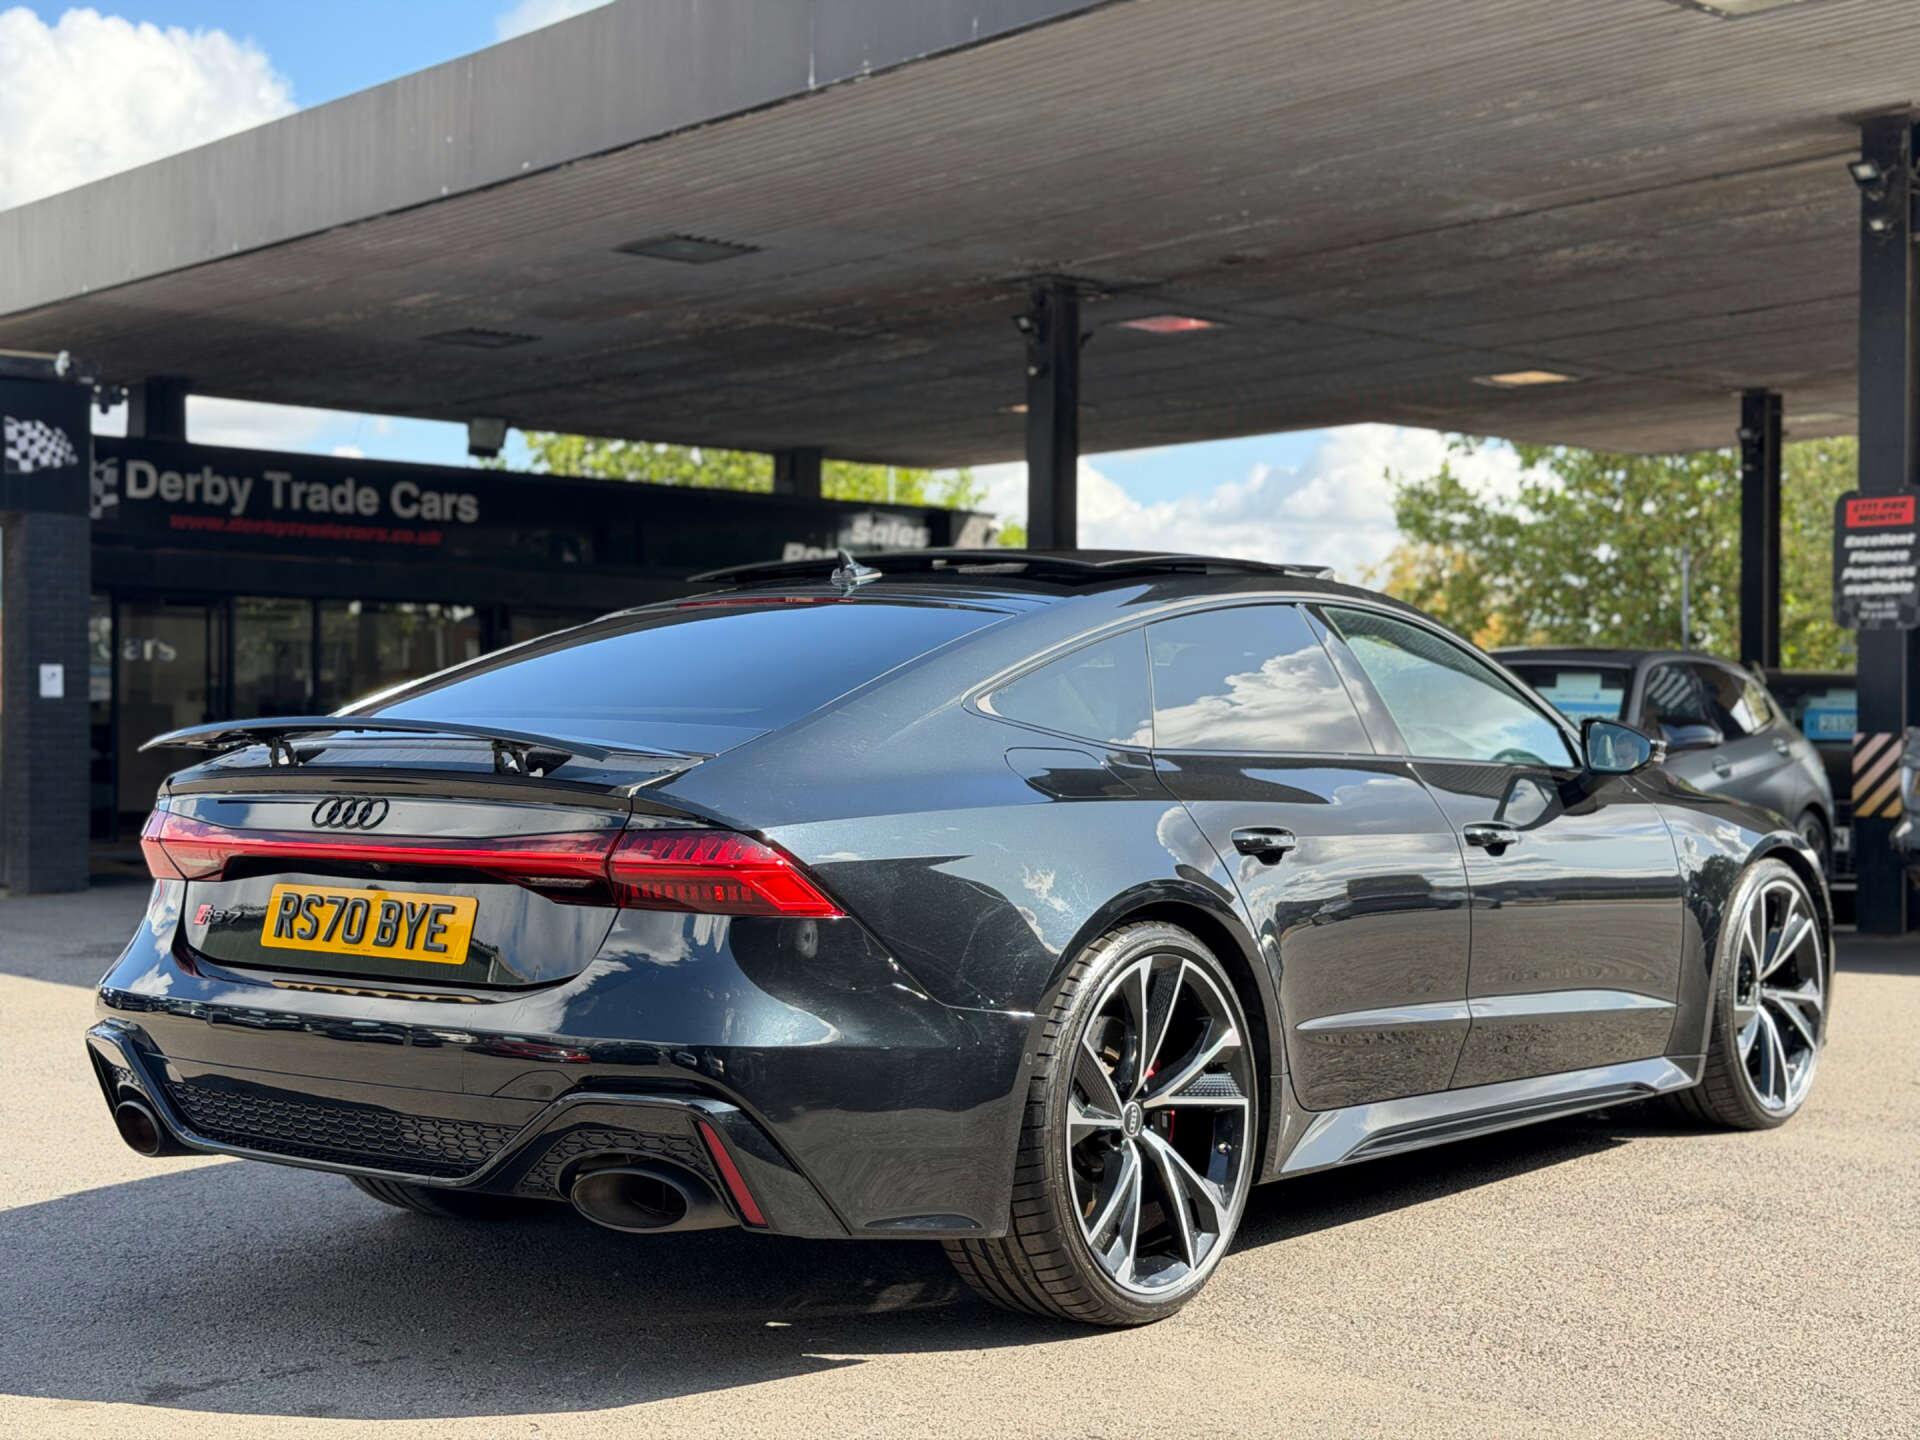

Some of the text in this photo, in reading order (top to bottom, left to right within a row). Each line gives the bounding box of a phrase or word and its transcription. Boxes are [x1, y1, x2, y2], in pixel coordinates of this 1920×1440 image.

[125, 459, 480, 524] Derby Trade Cars
[850, 513, 931, 549] Sales
[273, 891, 457, 954] RS70 BYE
